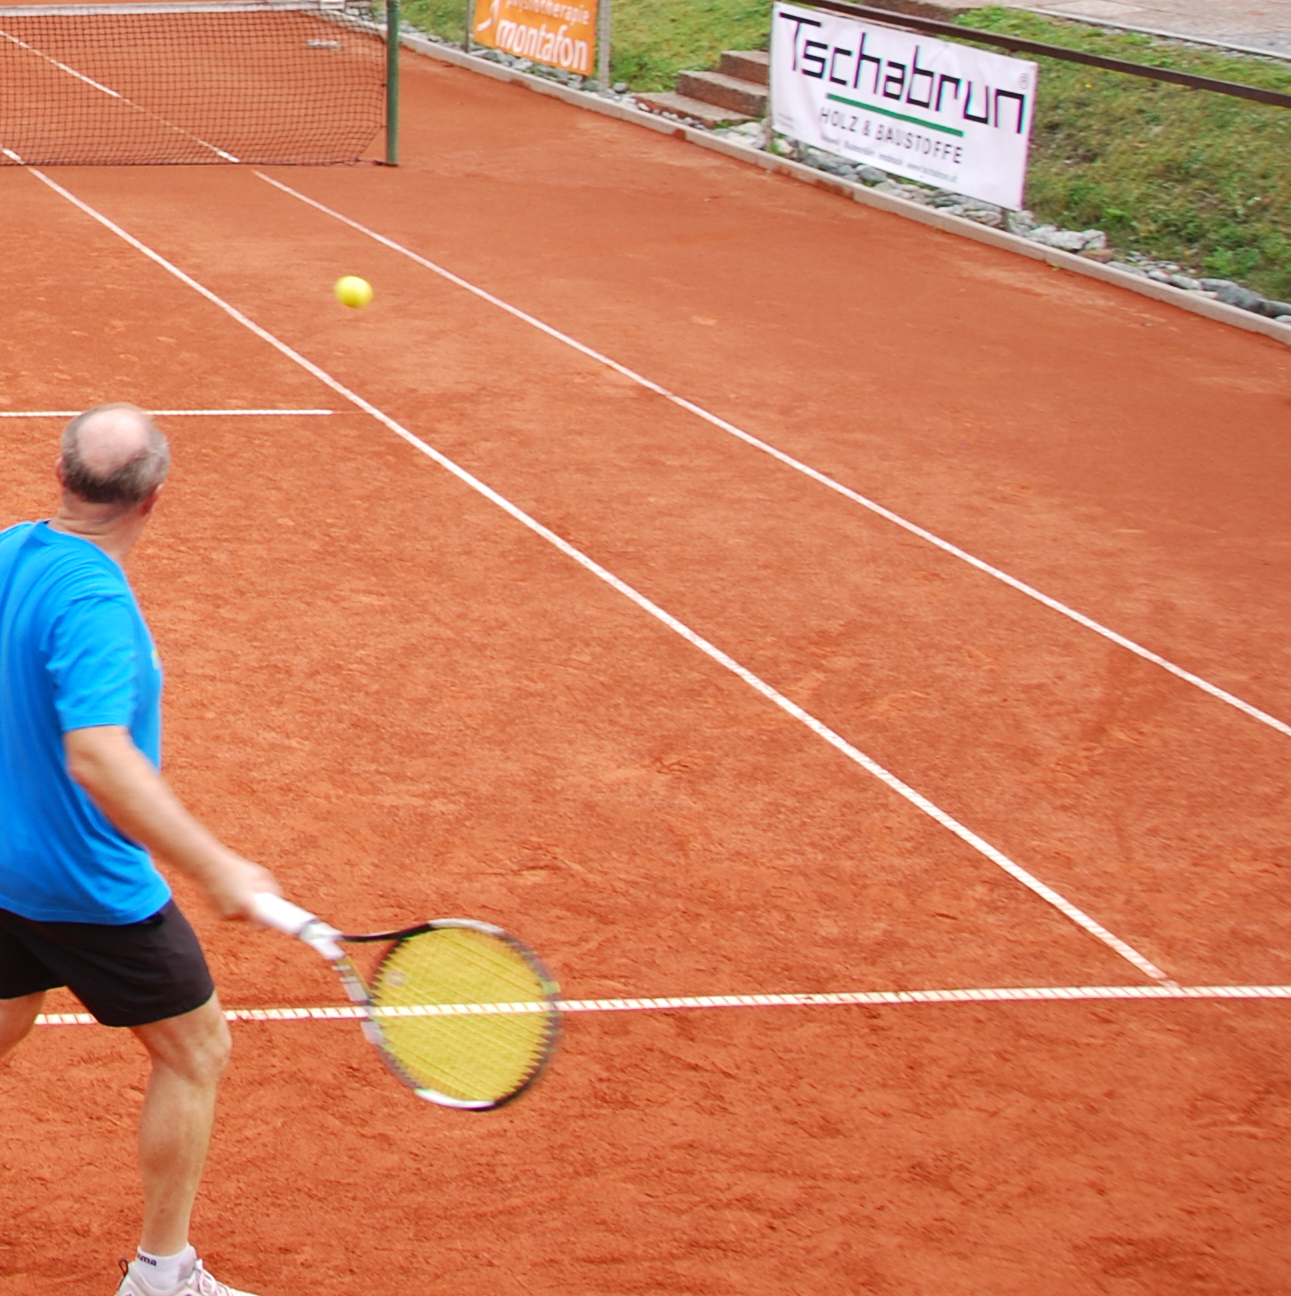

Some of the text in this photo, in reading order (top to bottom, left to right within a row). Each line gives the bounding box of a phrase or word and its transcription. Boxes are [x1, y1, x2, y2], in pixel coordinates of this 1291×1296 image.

[495, 18, 589, 72] montafon
[779, 11, 1026, 135] Tschabrun
[820, 106, 859, 133] HOLZ
[862, 120, 872, 137] &
[875, 123, 963, 165] BAUSTOFFE
